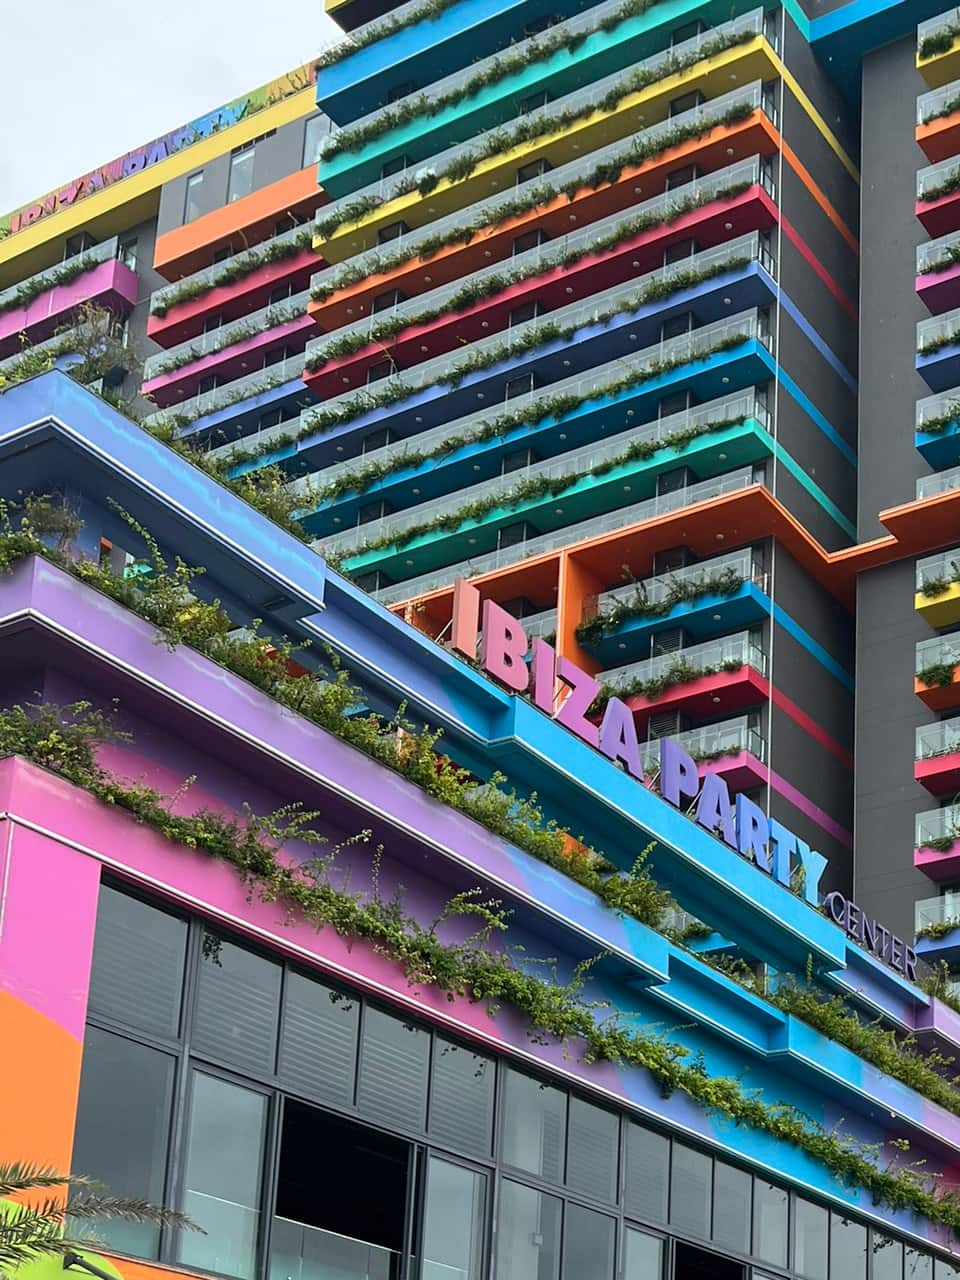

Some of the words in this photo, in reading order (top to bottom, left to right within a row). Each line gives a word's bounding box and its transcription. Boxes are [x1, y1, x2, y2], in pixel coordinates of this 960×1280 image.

[451, 578, 644, 782] IBIZA
[660, 736, 829, 907] PARTY
[823, 891, 918, 982] CENTER
